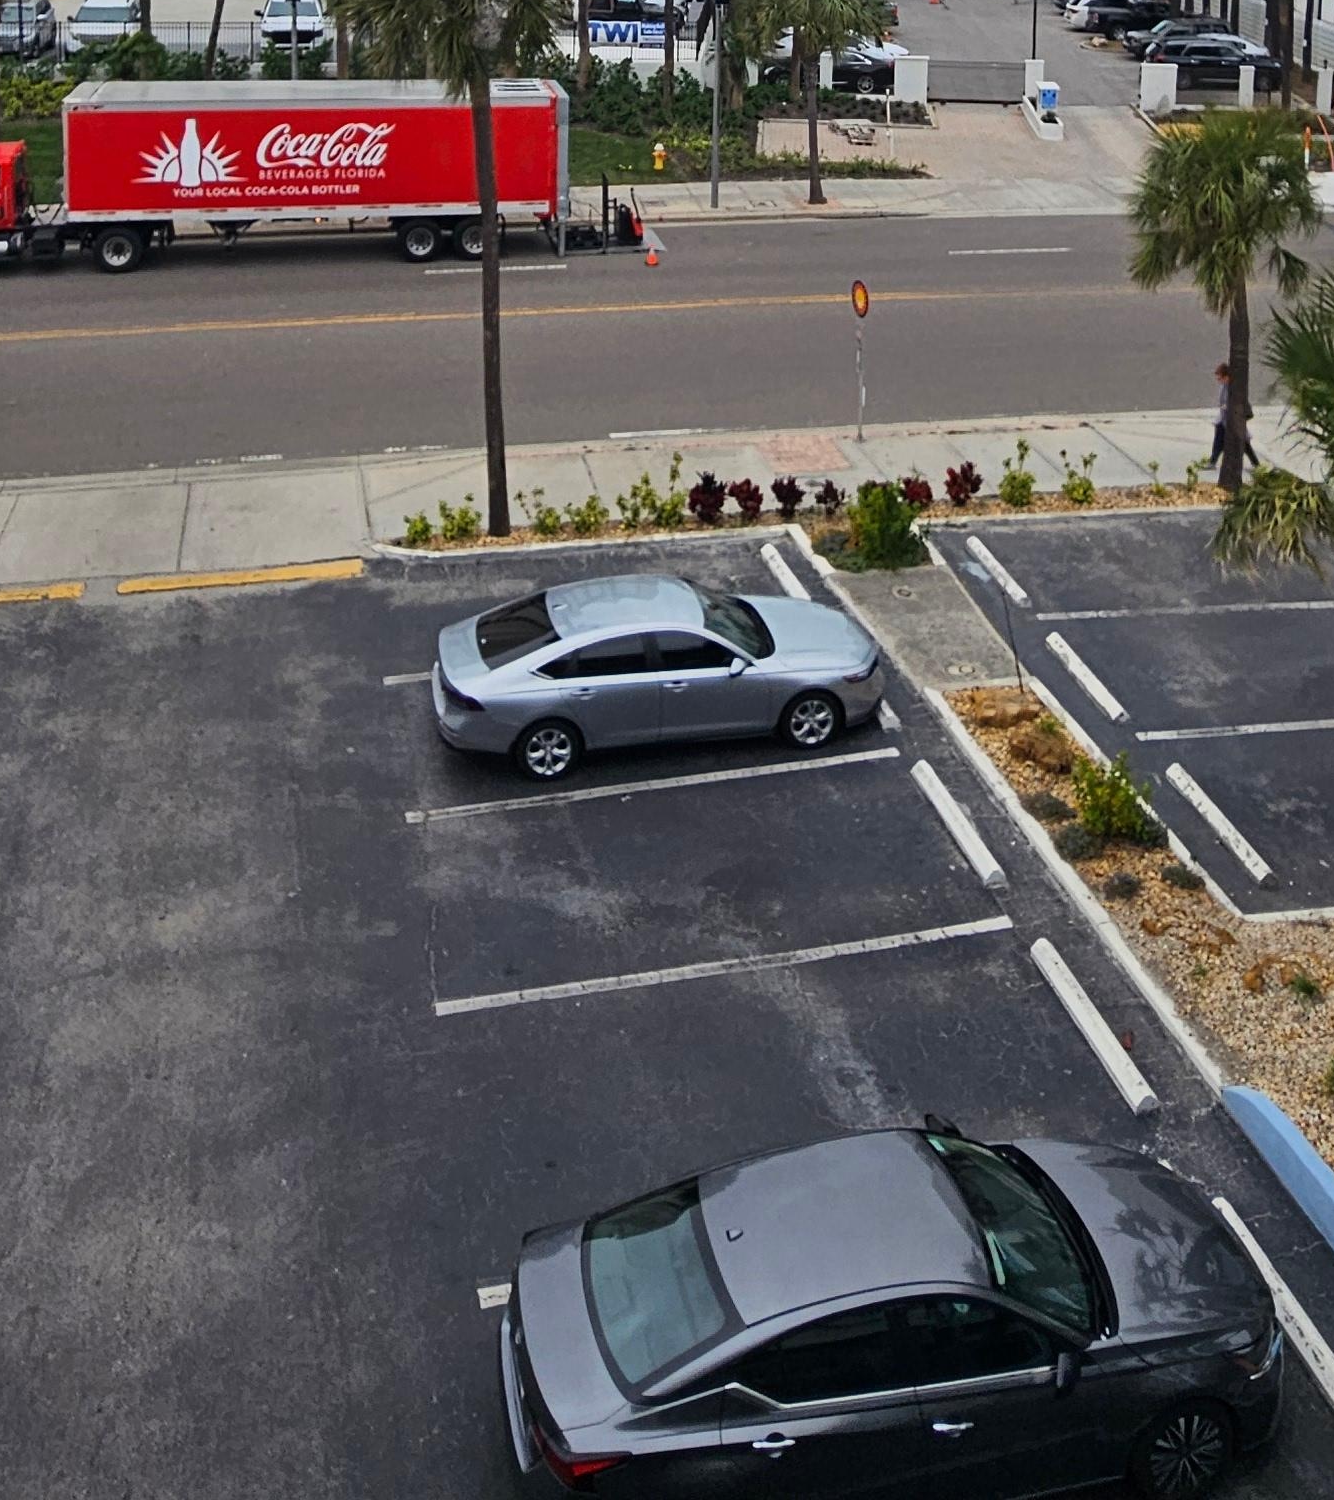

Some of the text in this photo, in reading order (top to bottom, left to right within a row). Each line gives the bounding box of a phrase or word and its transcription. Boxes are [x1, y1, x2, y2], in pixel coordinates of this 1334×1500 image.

[588, 23, 638, 42] TWI
[256, 123, 396, 168] Coca-Cola
[259, 168, 386, 180] BEVERAGES FLORIDA
[173, 184, 360, 198] YOUR LOCAL COCA-COLA BOTTLER
